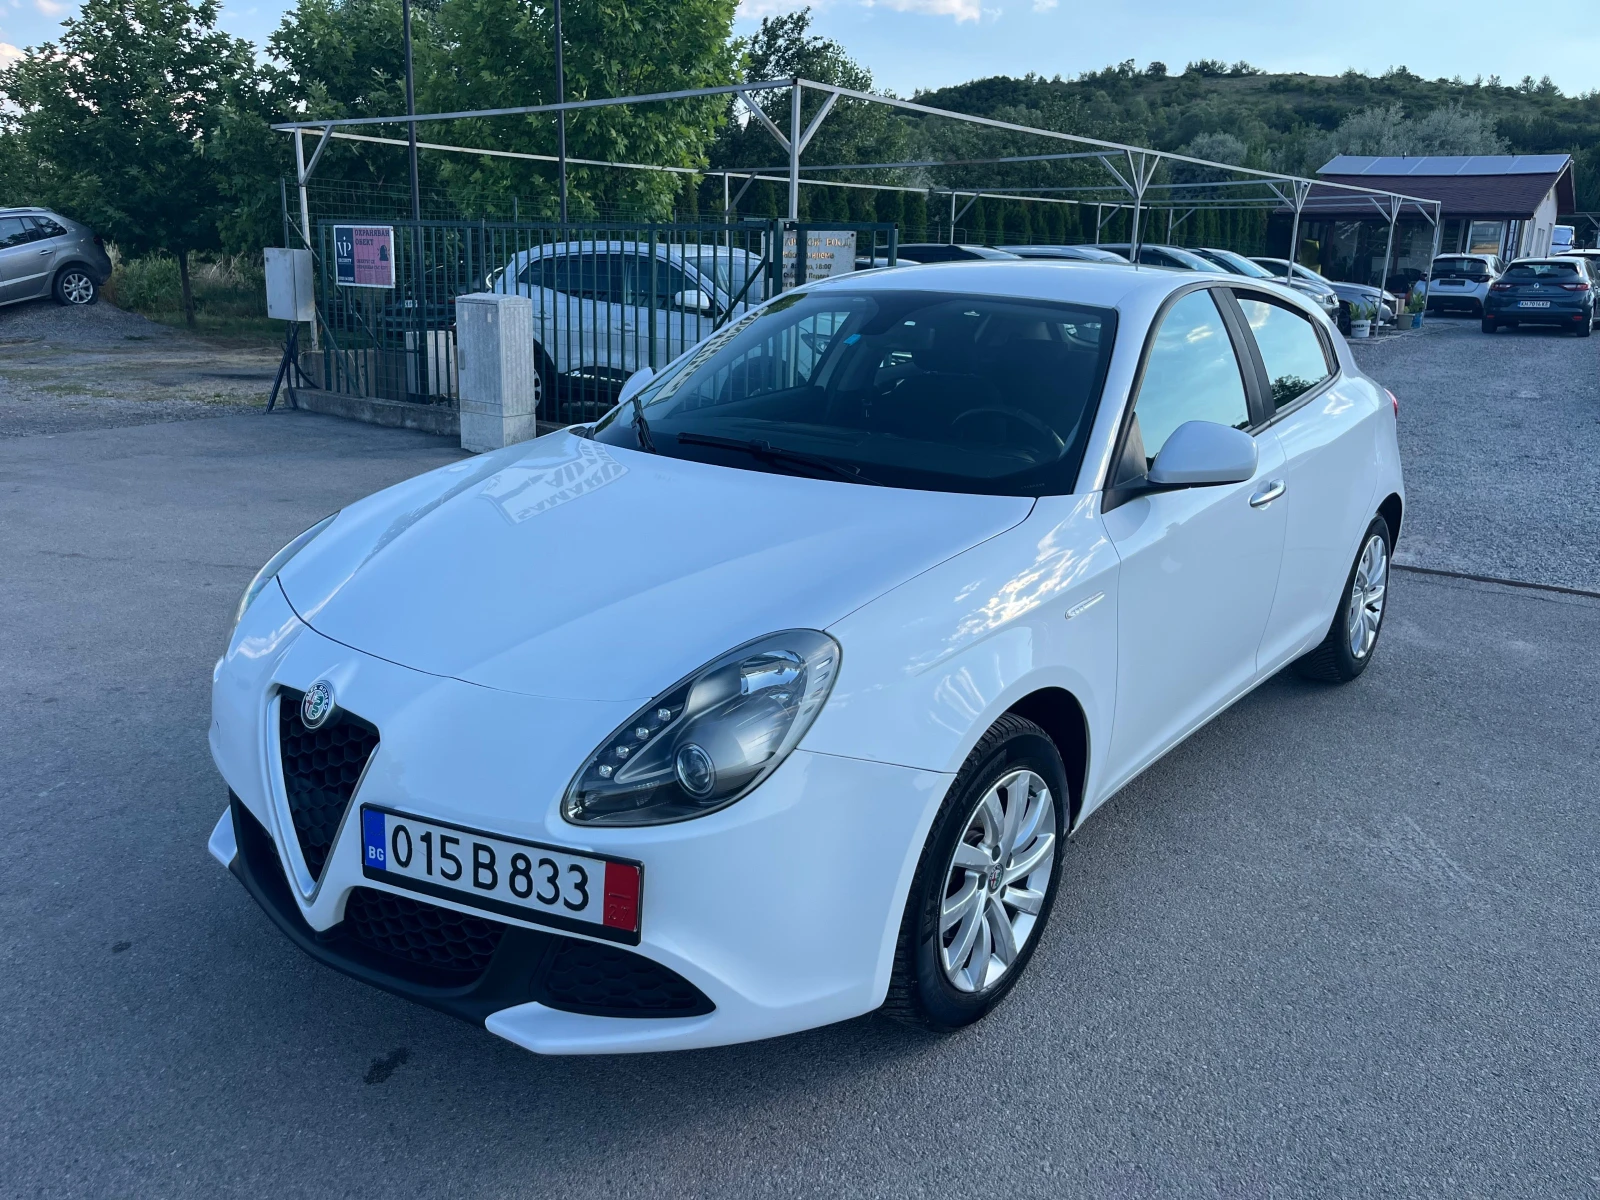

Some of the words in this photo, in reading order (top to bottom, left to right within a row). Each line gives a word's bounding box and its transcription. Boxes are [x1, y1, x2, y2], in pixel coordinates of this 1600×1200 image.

[354, 229, 389, 237] ОХРАНЯВАН
[355, 238, 374, 246] ОБЕКТ
[368, 845, 384, 862] BG
